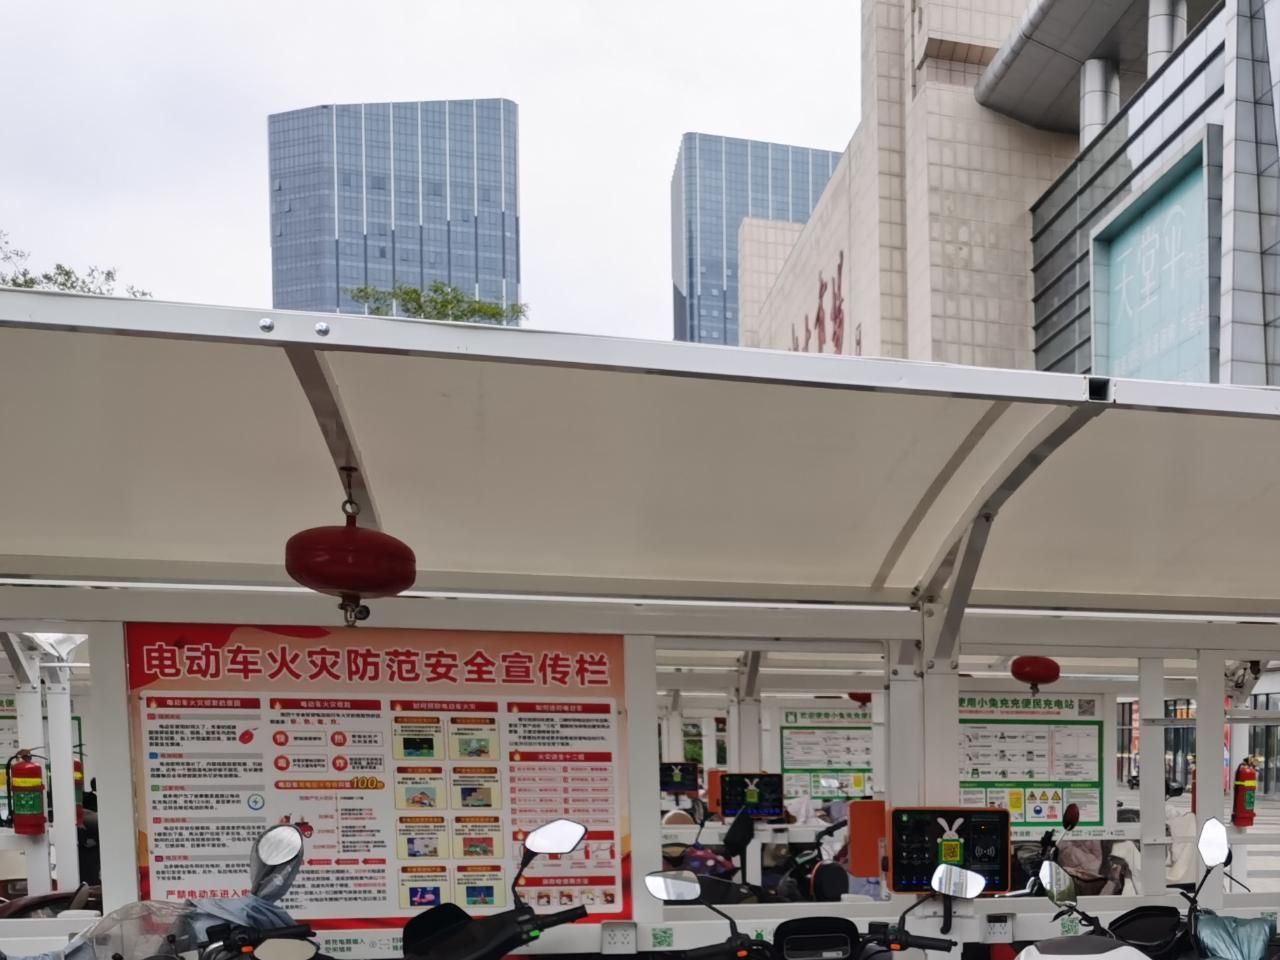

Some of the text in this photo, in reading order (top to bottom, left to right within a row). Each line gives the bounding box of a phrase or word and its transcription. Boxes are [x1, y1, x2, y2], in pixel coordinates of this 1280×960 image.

[142, 642, 610, 688] 电动车火灾防范安全宣传栏
